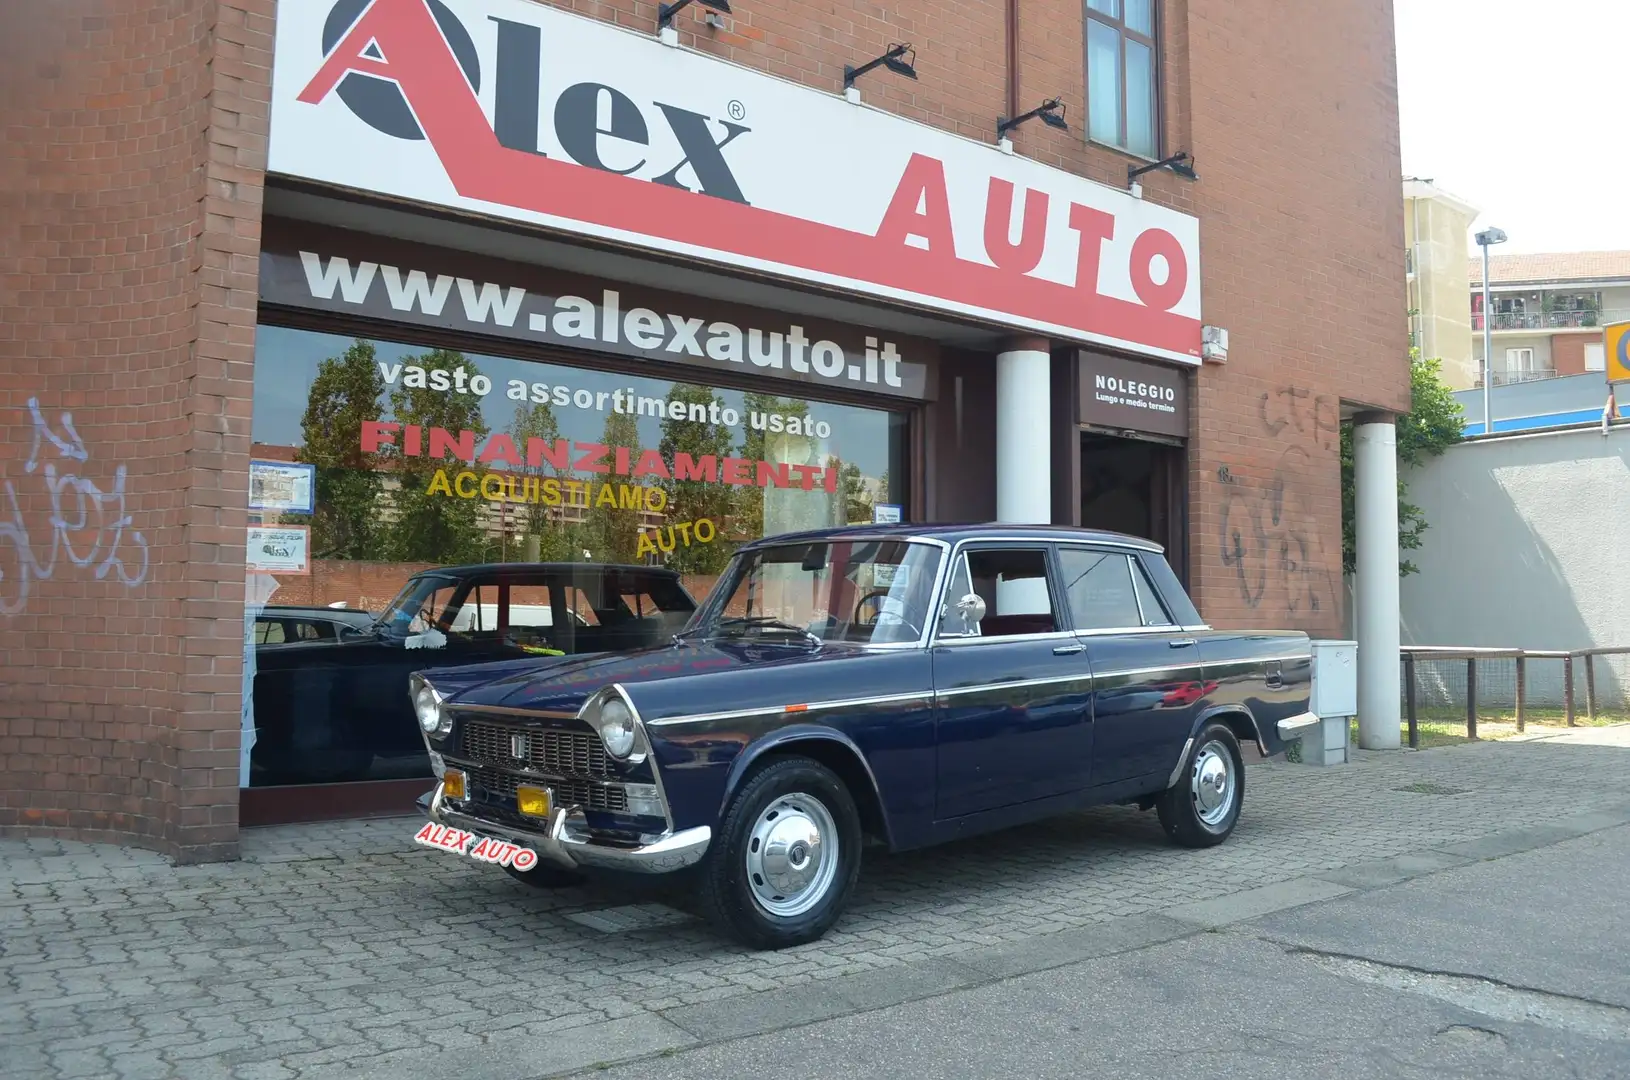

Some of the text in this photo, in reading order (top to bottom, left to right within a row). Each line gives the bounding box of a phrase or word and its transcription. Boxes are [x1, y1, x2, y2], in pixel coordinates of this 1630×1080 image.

[296, 0, 751, 206] Alex
[875, 152, 1188, 311] AUTO
[299, 251, 902, 387] www.alexauto.it
[378, 361, 831, 438] vasto assortimento usato
[1095, 374, 1175, 401] NOLEGGIO
[1095, 391, 1118, 404] Lungo
[1125, 398, 1148, 408] medio
[1148, 401, 1175, 413] termine
[360, 420, 838, 494] FINANZIAMENTI
[426, 469, 668, 512] ACQUISTIAMO
[636, 518, 715, 558] AUTO
